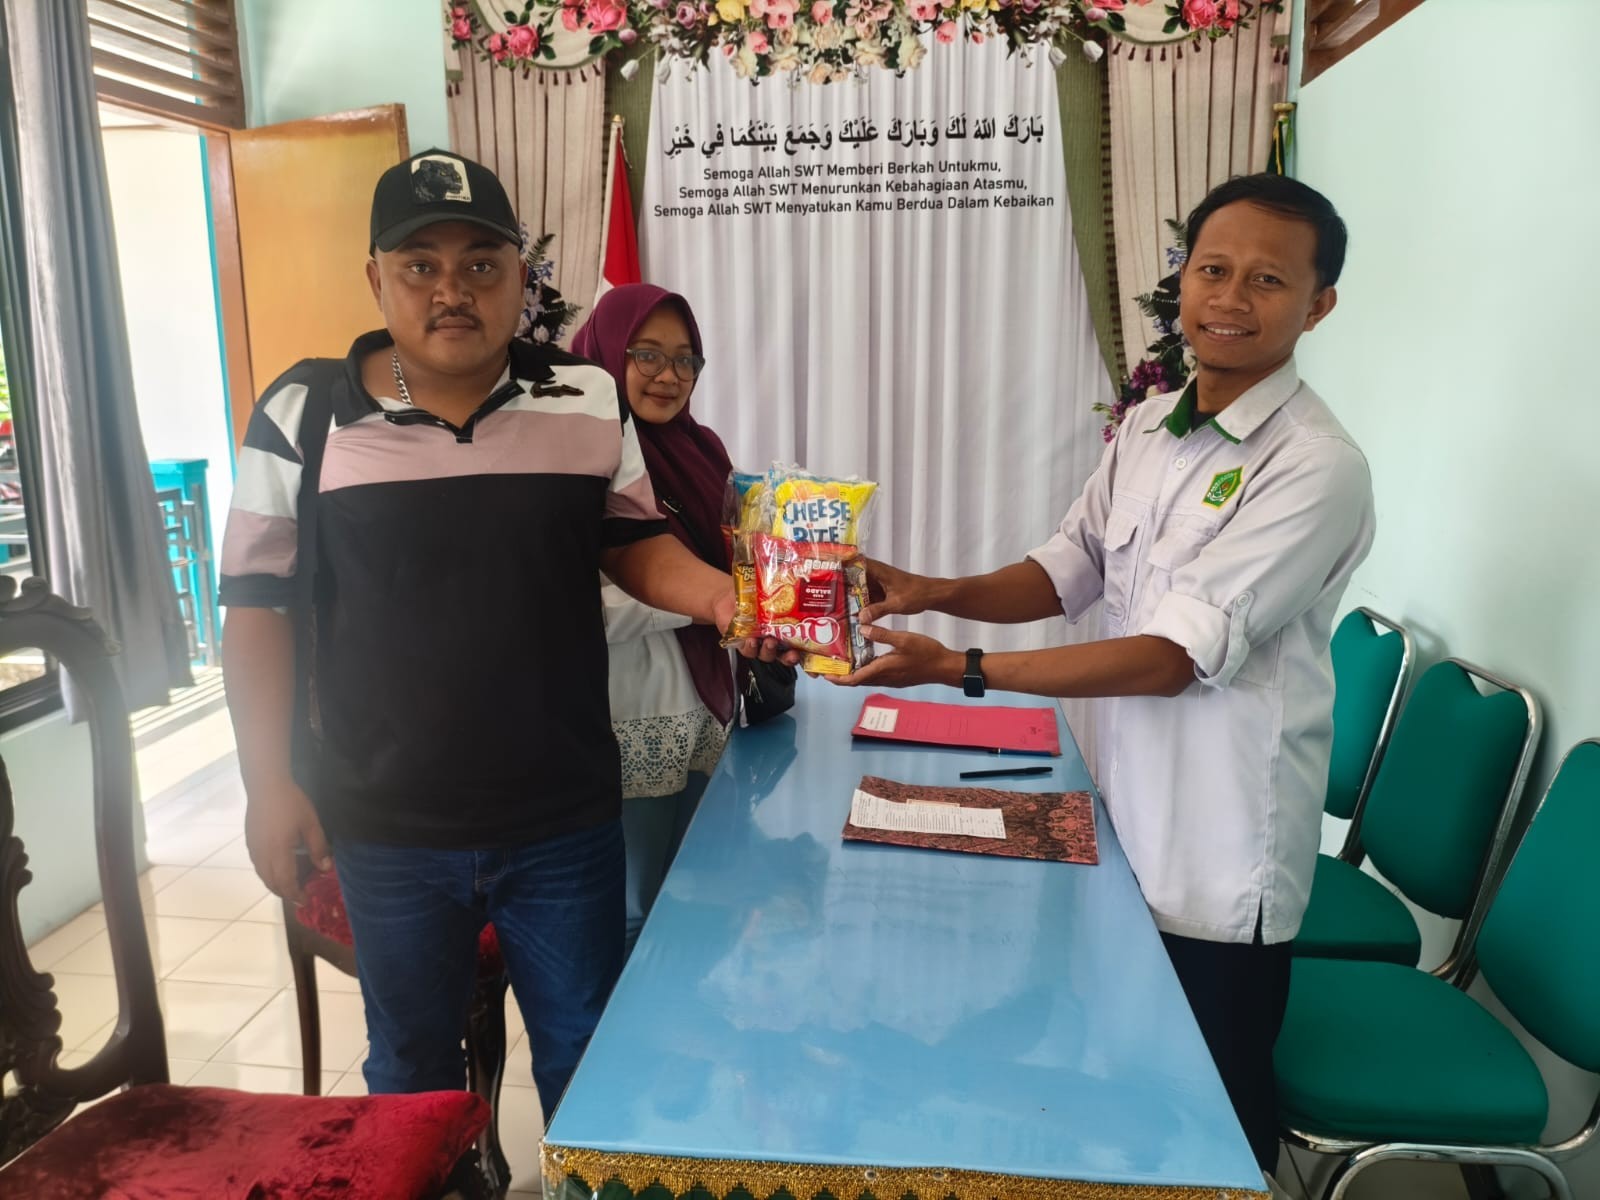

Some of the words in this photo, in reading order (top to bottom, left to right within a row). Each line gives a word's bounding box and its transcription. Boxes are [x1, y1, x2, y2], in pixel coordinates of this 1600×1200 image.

[703, 168, 754, 182] Semoga
[757, 165, 790, 179] Allah
[794, 164, 823, 178] SWT
[827, 163, 883, 177] Memberi
[887, 161, 934, 175] Berkah
[938, 160, 1001, 174] Untukmu,
[679, 186, 729, 201] Semoga
[733, 184, 765, 198] Allah
[769, 183, 798, 197] SWT
[801, 181, 881, 195] Menurunkan
[885, 179, 969, 194] Kebahagiaan
[973, 178, 1028, 191] Atasmu,
[654, 204, 703, 219] Semoga
[707, 203, 740, 216] Allah
[744, 202, 772, 215] SWT
[775, 200, 851, 216] Menyatukan
[856, 199, 892, 212] Kamu
[896, 197, 943, 211] Berdua
[948, 196, 989, 209] Dalam
[993, 194, 1054, 208] Kebaikan
[783, 498, 851, 525] CHEESE
